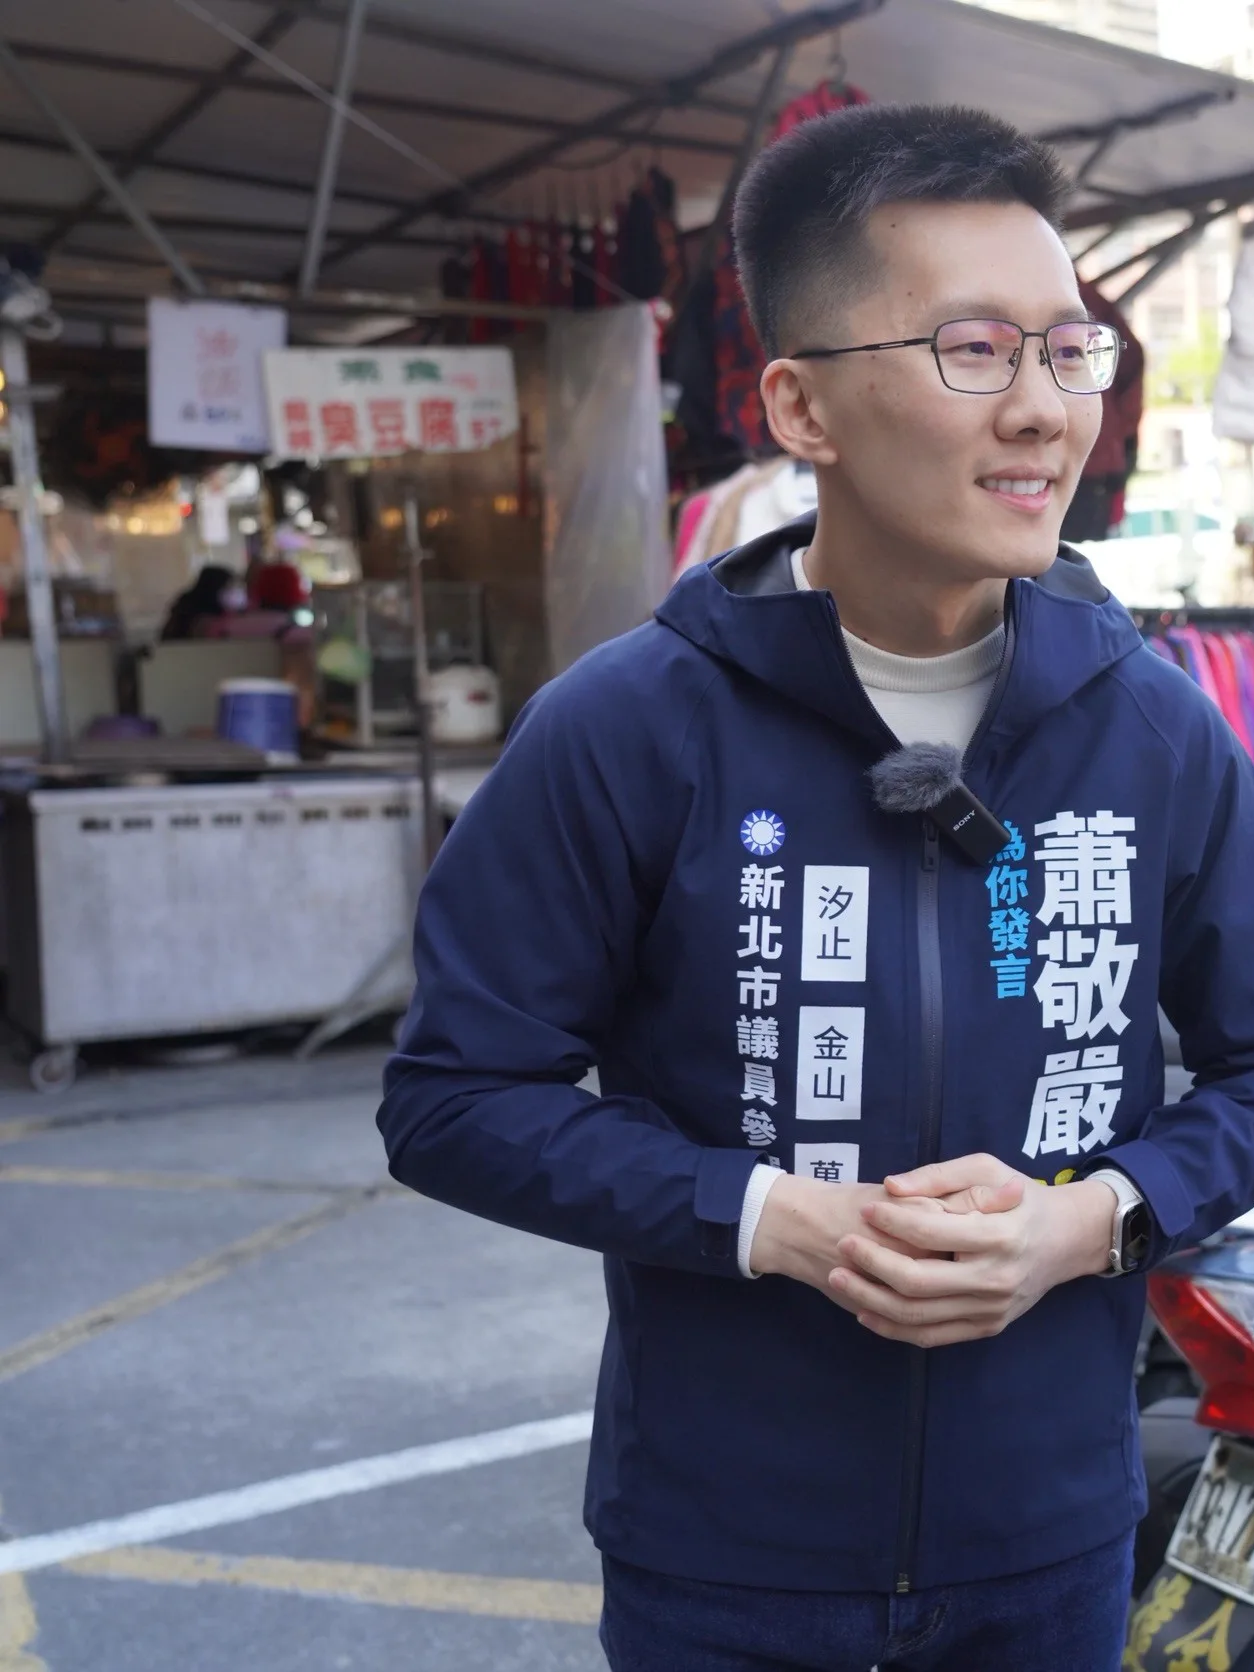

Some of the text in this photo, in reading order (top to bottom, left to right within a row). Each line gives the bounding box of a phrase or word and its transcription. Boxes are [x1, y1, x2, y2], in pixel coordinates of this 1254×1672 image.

[953, 809, 976, 832] SONY
[816, 885, 854, 961] 汐止
[985, 820, 1032, 999] 為你發言
[736, 863, 786, 1169] 新北市議員參
[1021, 810, 1139, 1160] 蕭敬嚴
[813, 1025, 850, 1102] 金山
